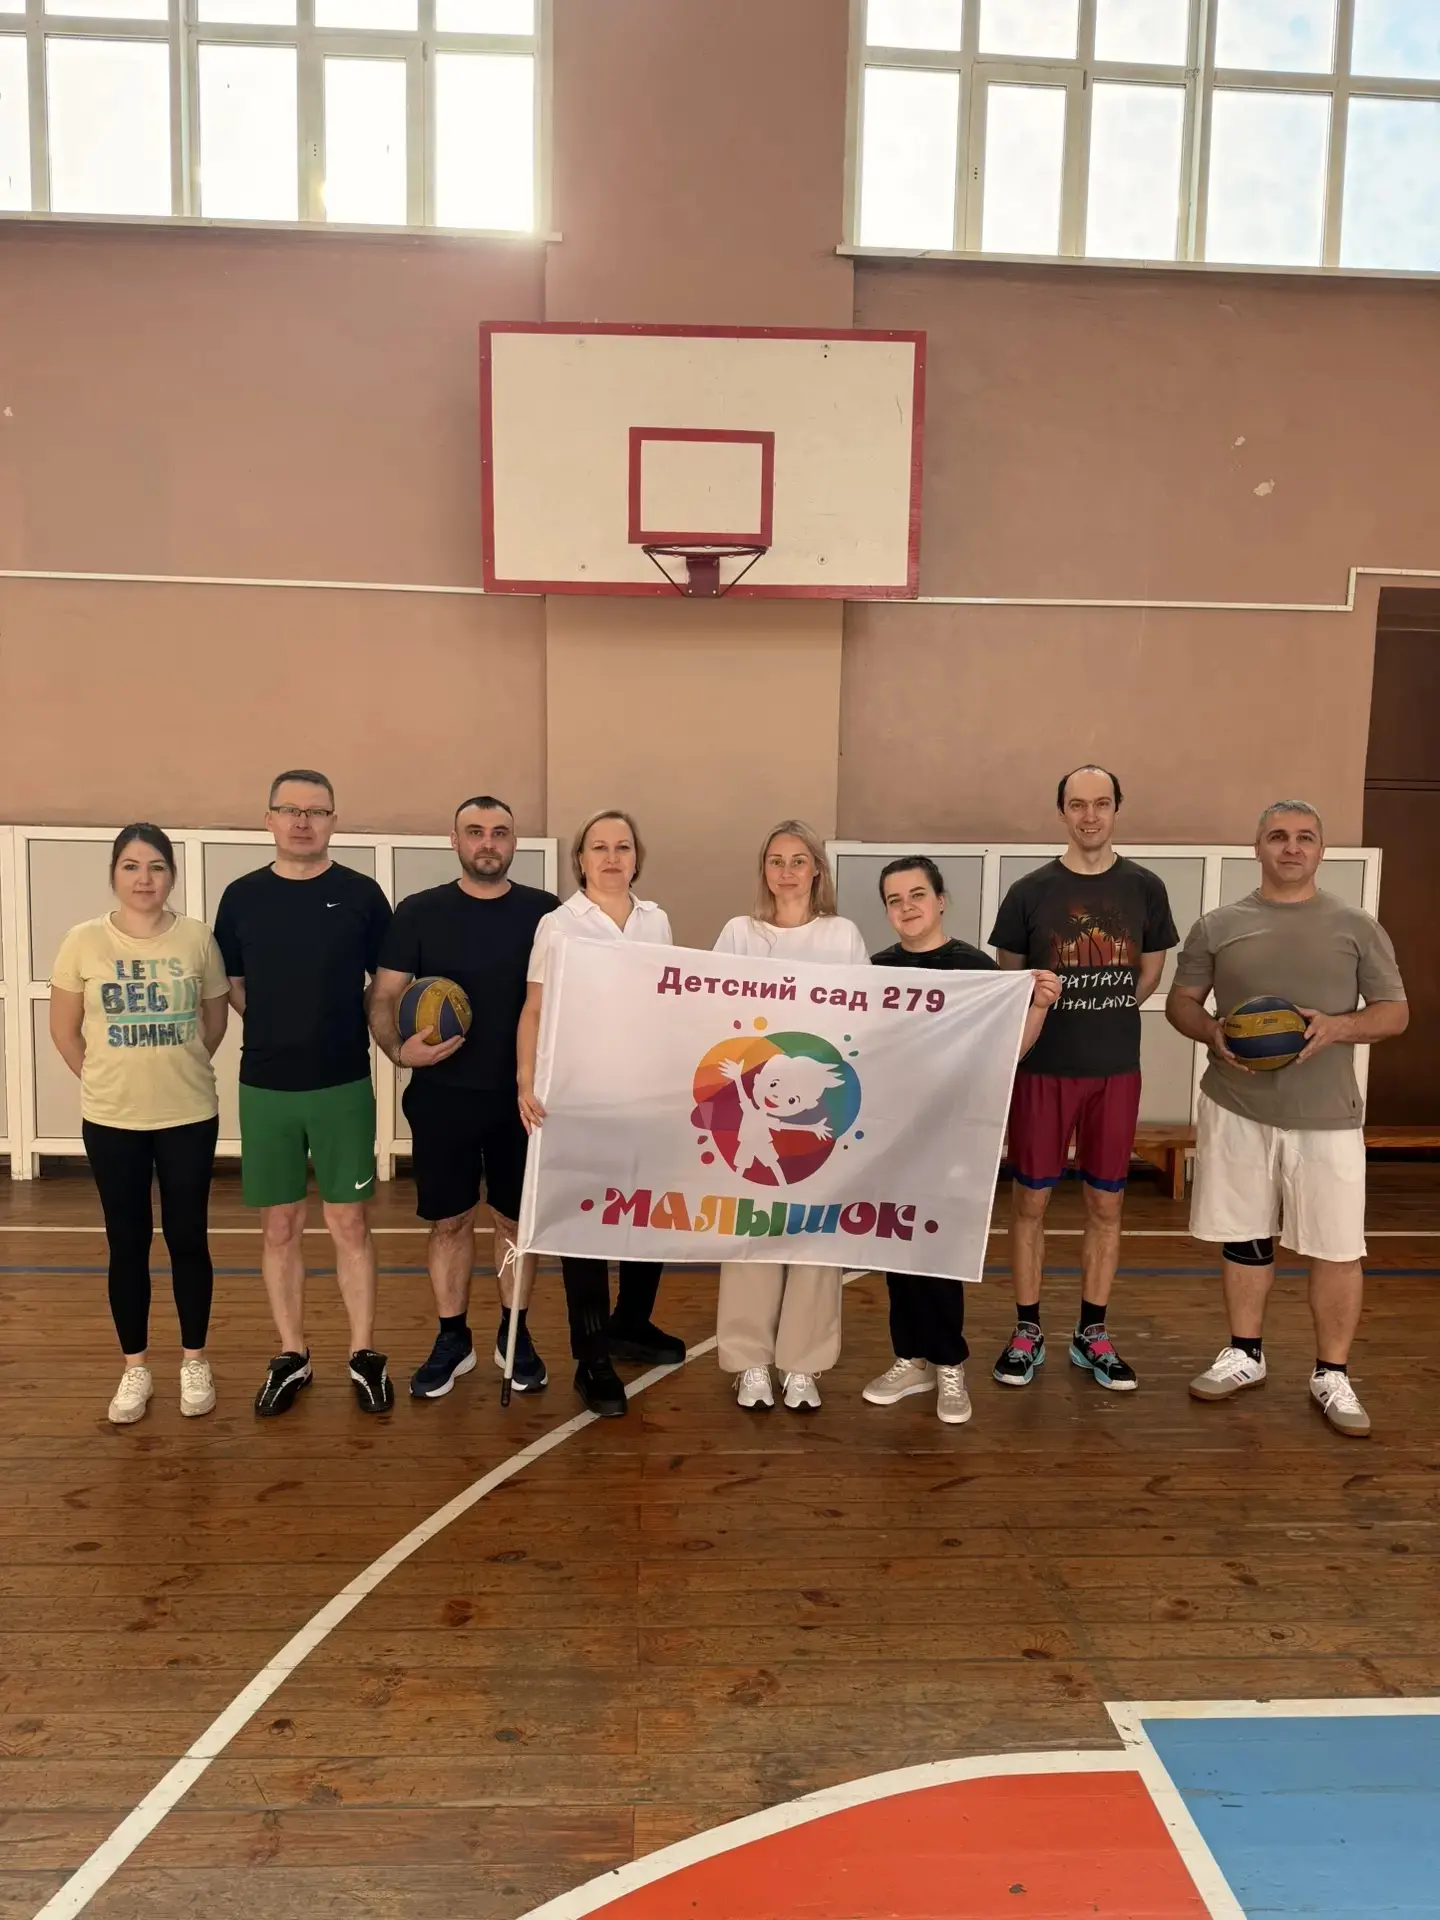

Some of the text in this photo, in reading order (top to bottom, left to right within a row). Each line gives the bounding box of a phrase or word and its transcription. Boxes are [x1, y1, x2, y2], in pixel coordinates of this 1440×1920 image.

[116, 957, 184, 980] LET'S
[1059, 971, 1134, 989] PATTAYA
[101, 977, 198, 1014] BEGIN
[657, 966, 946, 1012] Детский сад 279
[1053, 994, 1138, 1011] THAILAND
[107, 1020, 197, 1048] SUMMER
